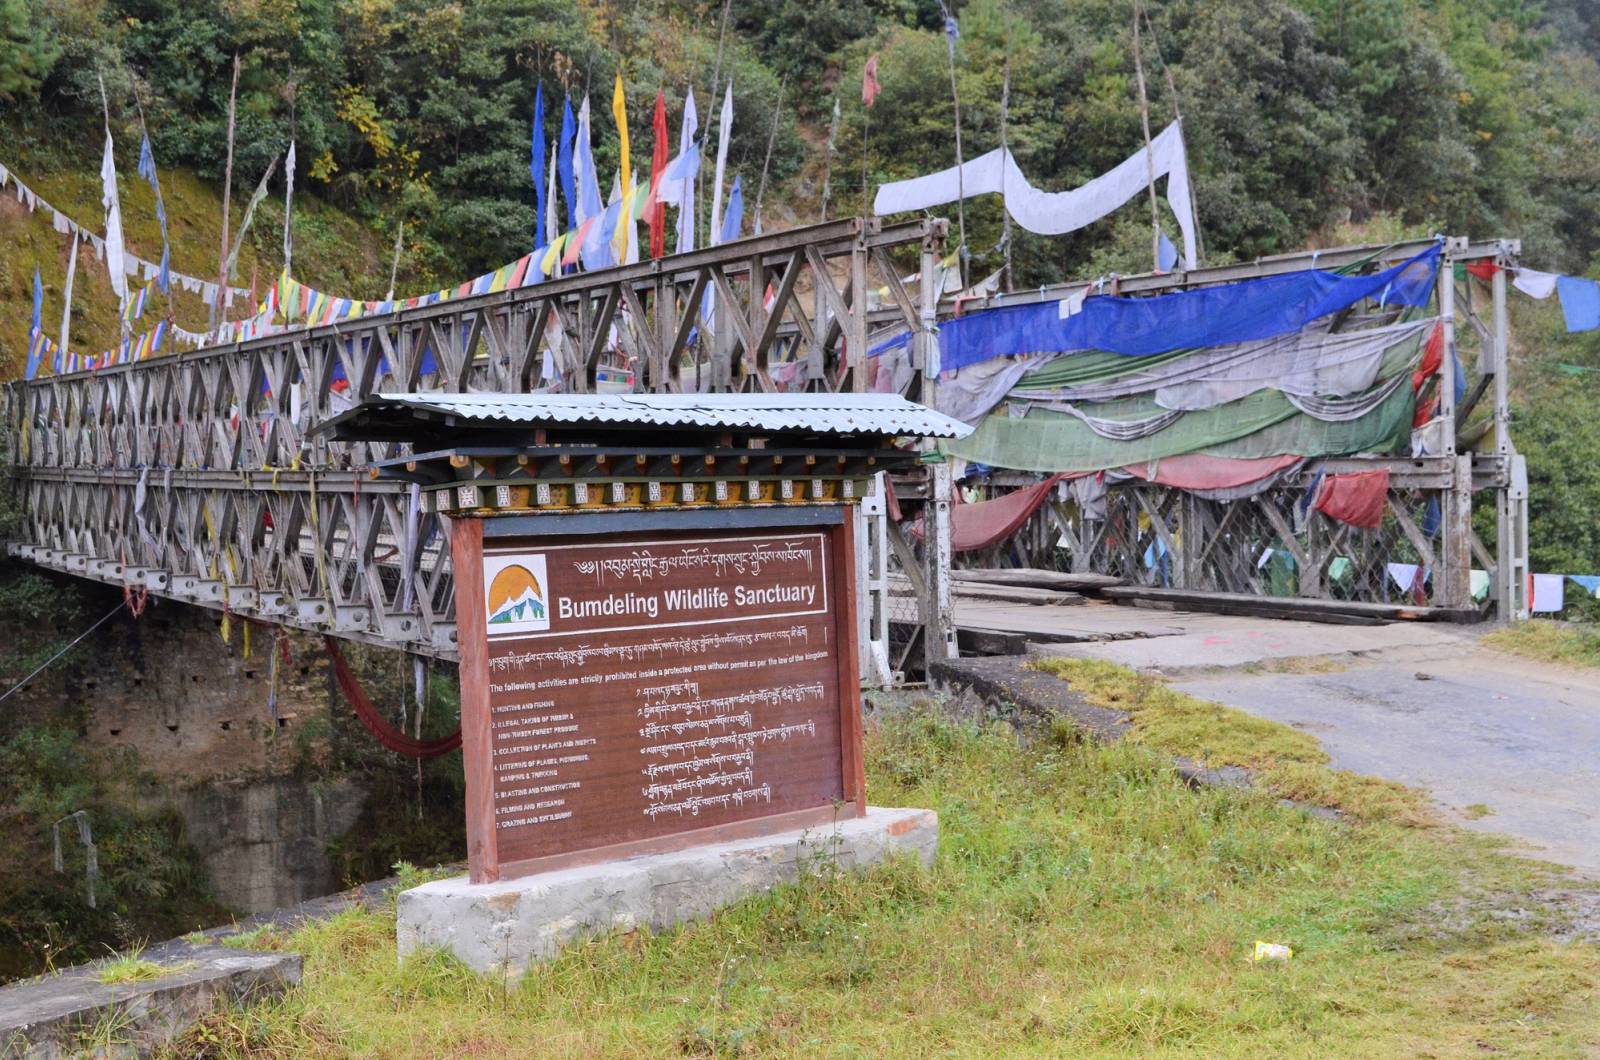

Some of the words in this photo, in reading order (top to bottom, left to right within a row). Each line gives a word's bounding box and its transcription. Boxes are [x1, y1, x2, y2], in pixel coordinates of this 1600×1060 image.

[559, 593, 658, 619] Bumdeling
[665, 585, 729, 610] Wildlife
[735, 583, 815, 606] Sanctuary
[490, 684, 503, 693] The
[504, 681, 535, 691] following
[538, 679, 566, 688] activities
[581, 674, 602, 684] strictly
[605, 671, 637, 682] prohibited
[639, 669, 657, 678] inside
[664, 667, 692, 676] protected
[708, 662, 728, 670] without
[730, 660, 748, 669] permit
[757, 659, 766, 668] per
[805, 650, 828, 660] kingdom
[521, 716, 540, 724] TAKING
[533, 728, 552, 736] FOREST
[499, 746, 532, 755] COLLECTION
[499, 762, 527, 770] LITTERING
[500, 774, 525, 782] CAMPING
[501, 789, 527, 798] BLASTING
[541, 782, 581, 792] CONSTRUCTION
[501, 805, 522, 813] FILMING
[502, 819, 526, 828] GRAZING
